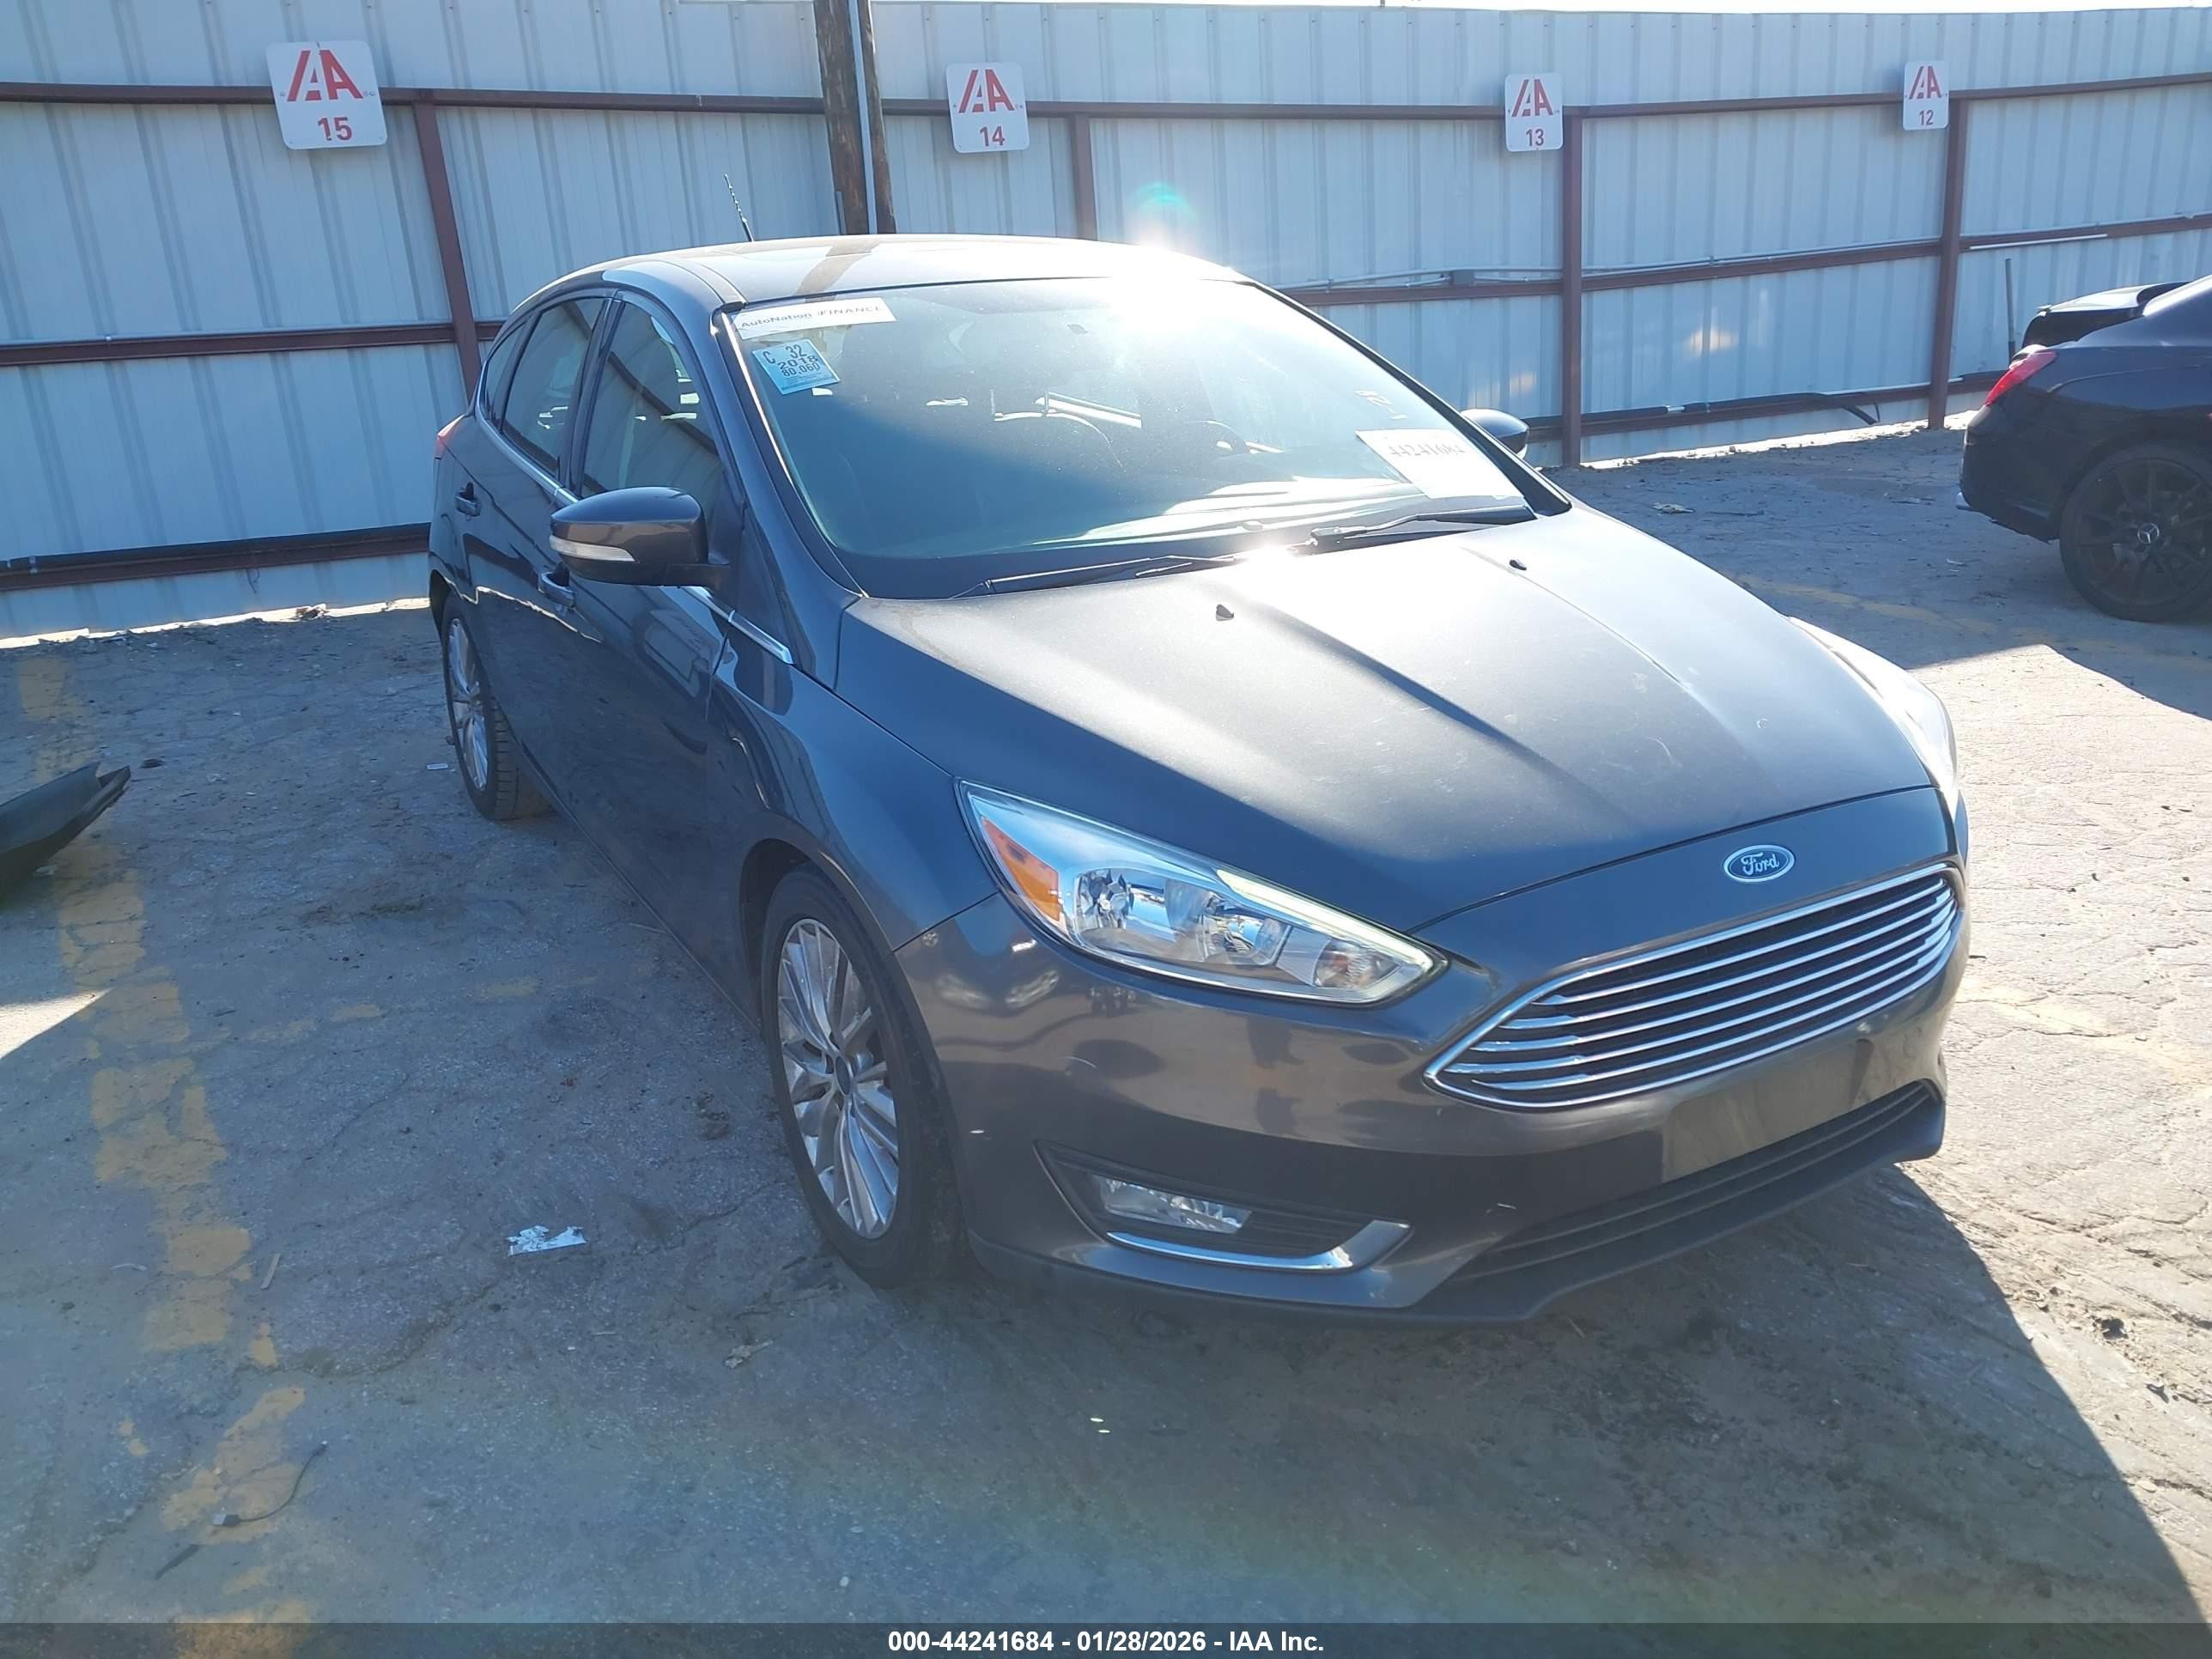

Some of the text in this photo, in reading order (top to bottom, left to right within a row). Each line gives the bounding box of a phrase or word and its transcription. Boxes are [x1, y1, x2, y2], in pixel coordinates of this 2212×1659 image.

[1919, 109, 1934, 125] 12
[318, 117, 352, 141] 15
[980, 125, 1006, 147] 14
[1526, 128, 1544, 146] 13
[740, 313, 812, 328] AutoNation
[763, 344, 807, 364] C 32
[777, 355, 818, 369] 2018
[1741, 852, 1779, 875] Ford
